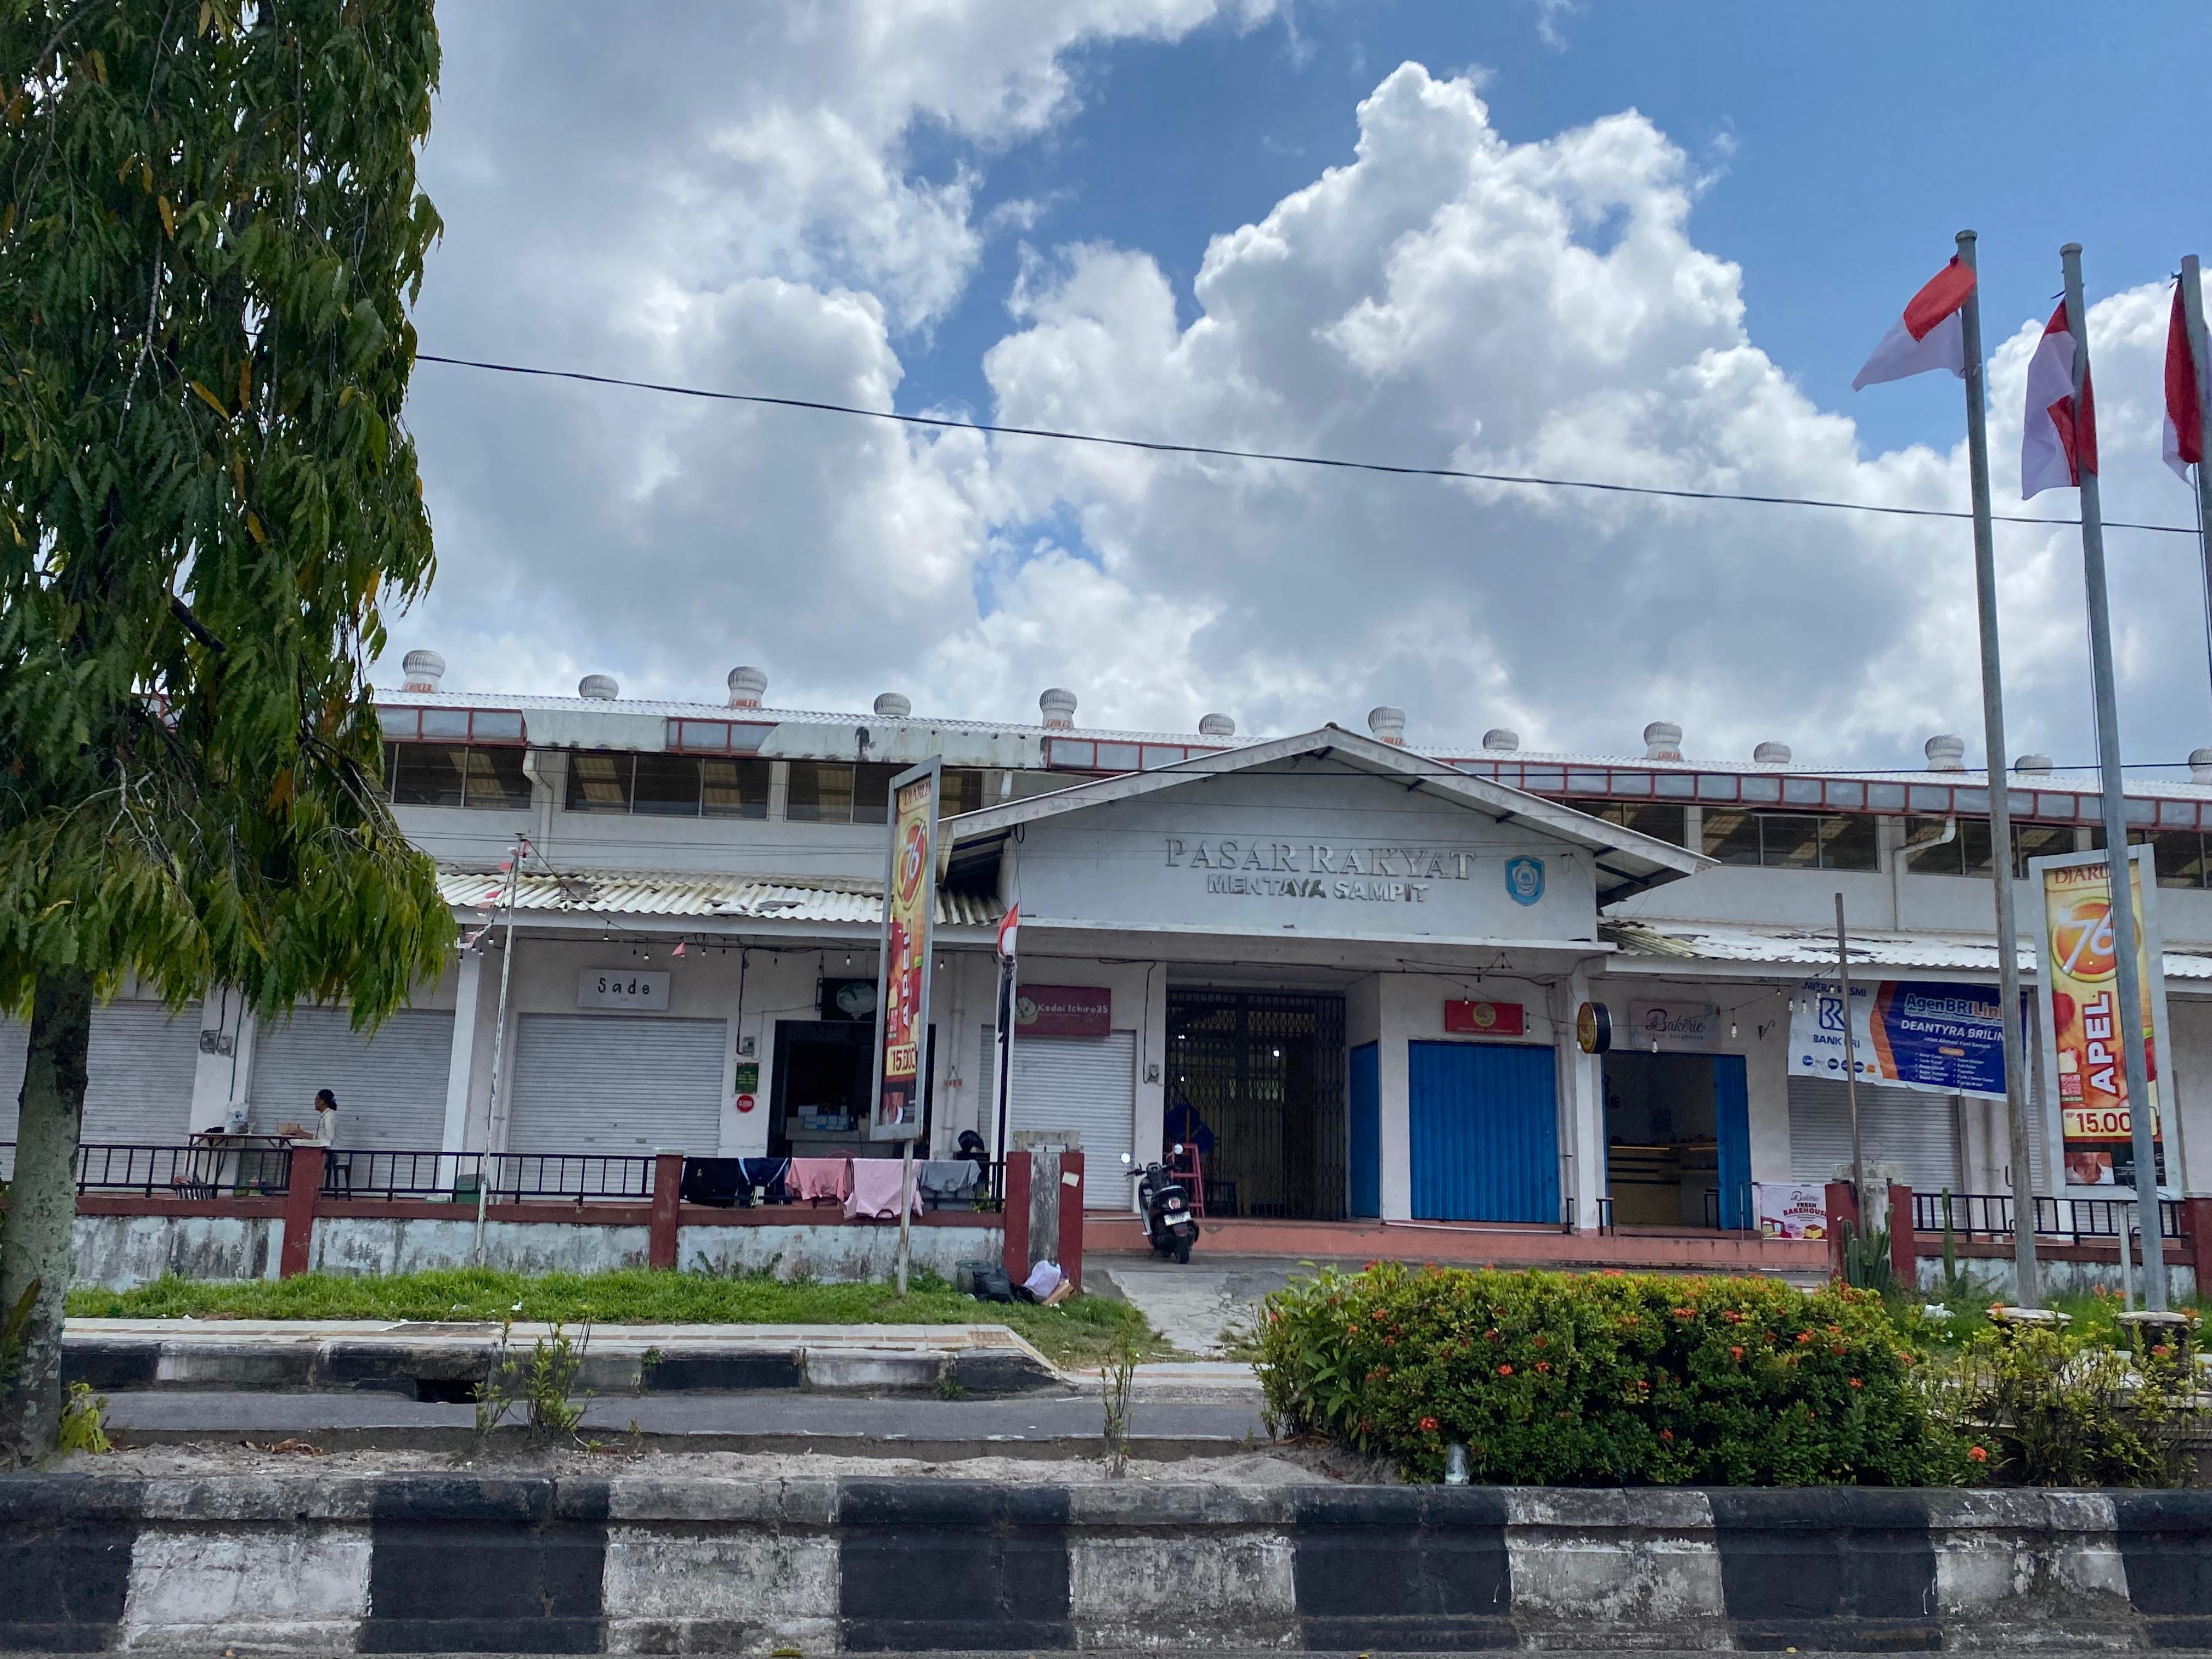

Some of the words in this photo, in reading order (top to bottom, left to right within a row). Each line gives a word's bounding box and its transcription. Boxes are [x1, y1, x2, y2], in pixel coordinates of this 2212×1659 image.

[1165, 839, 1300, 872] PASAR
[1308, 845, 1476, 880] RAKYAT
[2054, 865, 2111, 884] DJARU
[1207, 873, 1327, 898] MENTAYA
[1333, 879, 1429, 902] SAMPIT
[2058, 906, 2116, 974] 76
[597, 977, 650, 995] Sade
[1837, 985, 1867, 997] RSMI
[1037, 1002, 1065, 1012] Kedai
[1813, 1034, 1842, 1046] BANK
[1901, 1020, 1965, 1037] DEANTYRA
[1967, 1028, 2004, 1042] BRILIN
[2084, 991, 2118, 1095] APEL
[2076, 1112, 2132, 1133] 15.00
[1783, 1207, 1826, 1216] BAKEHOUS
